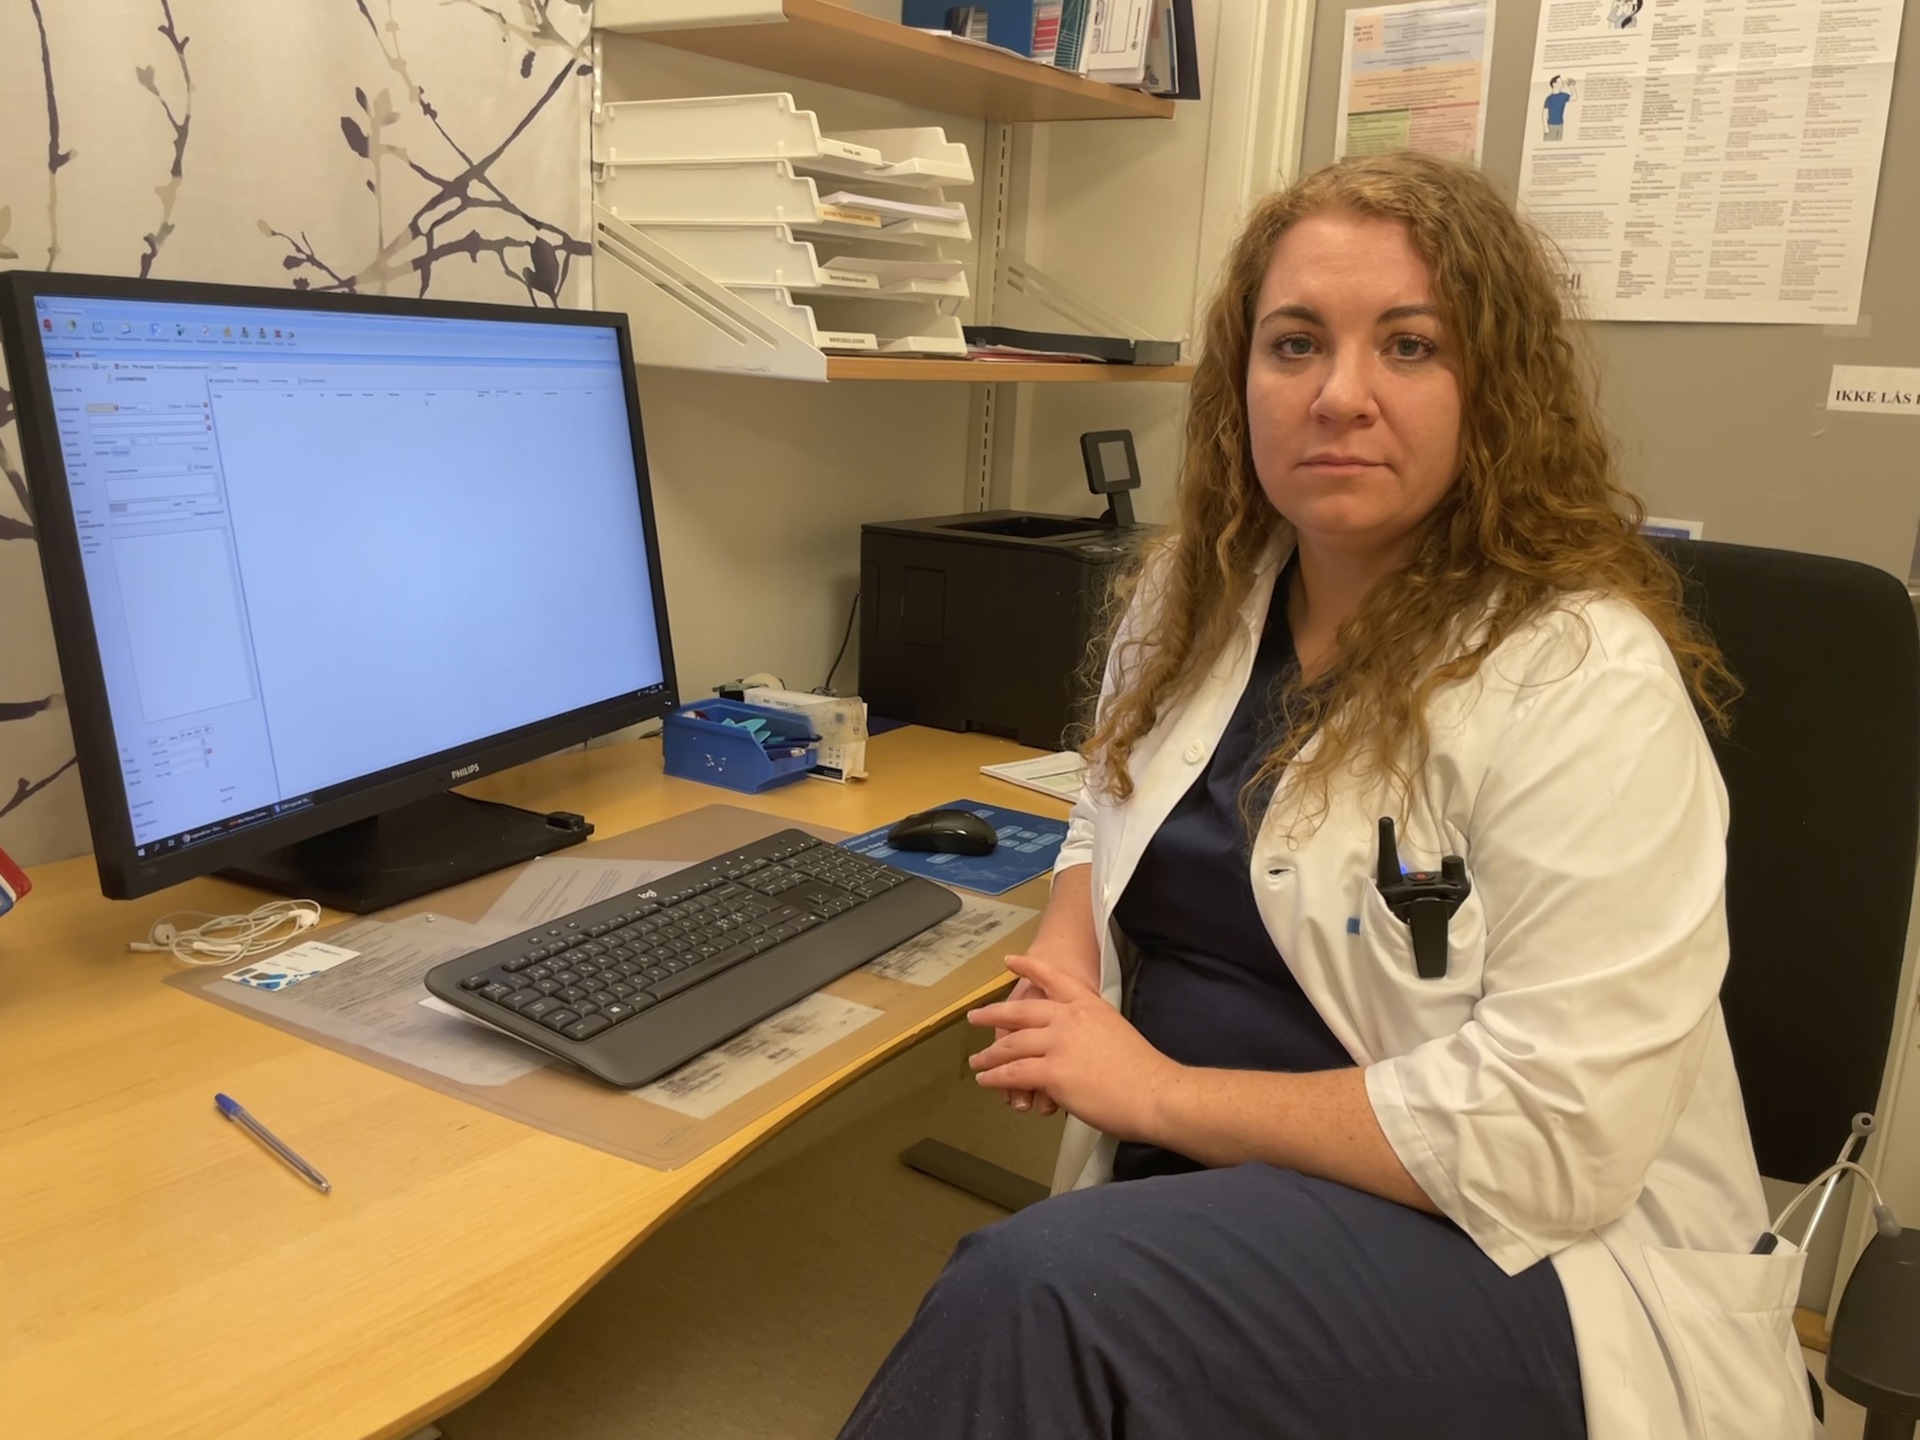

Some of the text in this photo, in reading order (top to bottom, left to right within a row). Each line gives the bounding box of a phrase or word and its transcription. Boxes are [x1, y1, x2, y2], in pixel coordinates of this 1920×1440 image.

[1836, 389, 1876, 403] IKKE
[1881, 390, 1912, 404] LÅS
[451, 763, 480, 780] PHILIPS
[637, 889, 657, 899] logi
